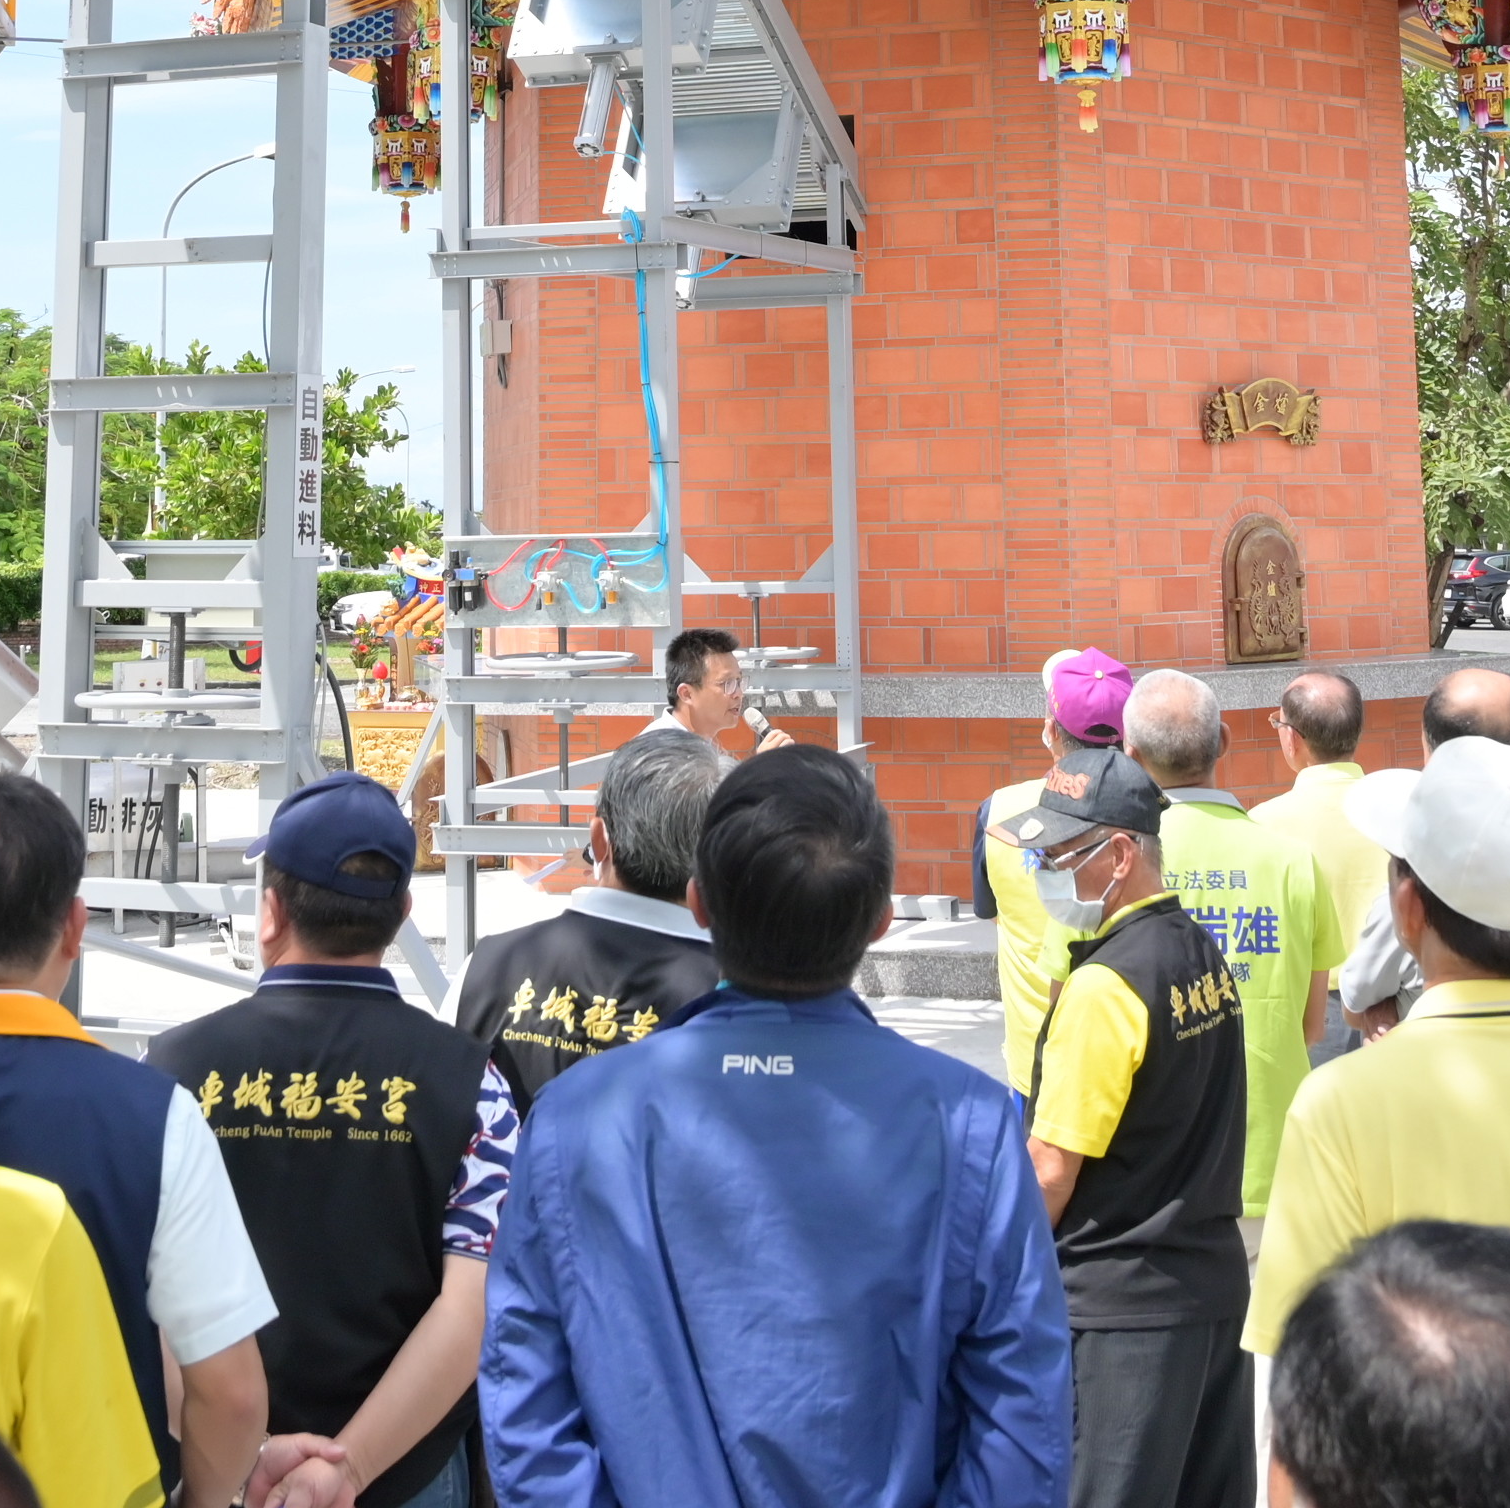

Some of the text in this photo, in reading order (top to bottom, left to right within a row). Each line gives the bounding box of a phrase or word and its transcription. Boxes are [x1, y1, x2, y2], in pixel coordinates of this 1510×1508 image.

[298, 386, 318, 545] 自動進料
[1163, 870, 1248, 890] 立法委員
[722, 1054, 794, 1075] PING
[213, 1124, 251, 1139] cheng
[287, 1126, 333, 1140] Temple
[348, 1127, 379, 1141] Since
[384, 1130, 412, 1142] 1662
